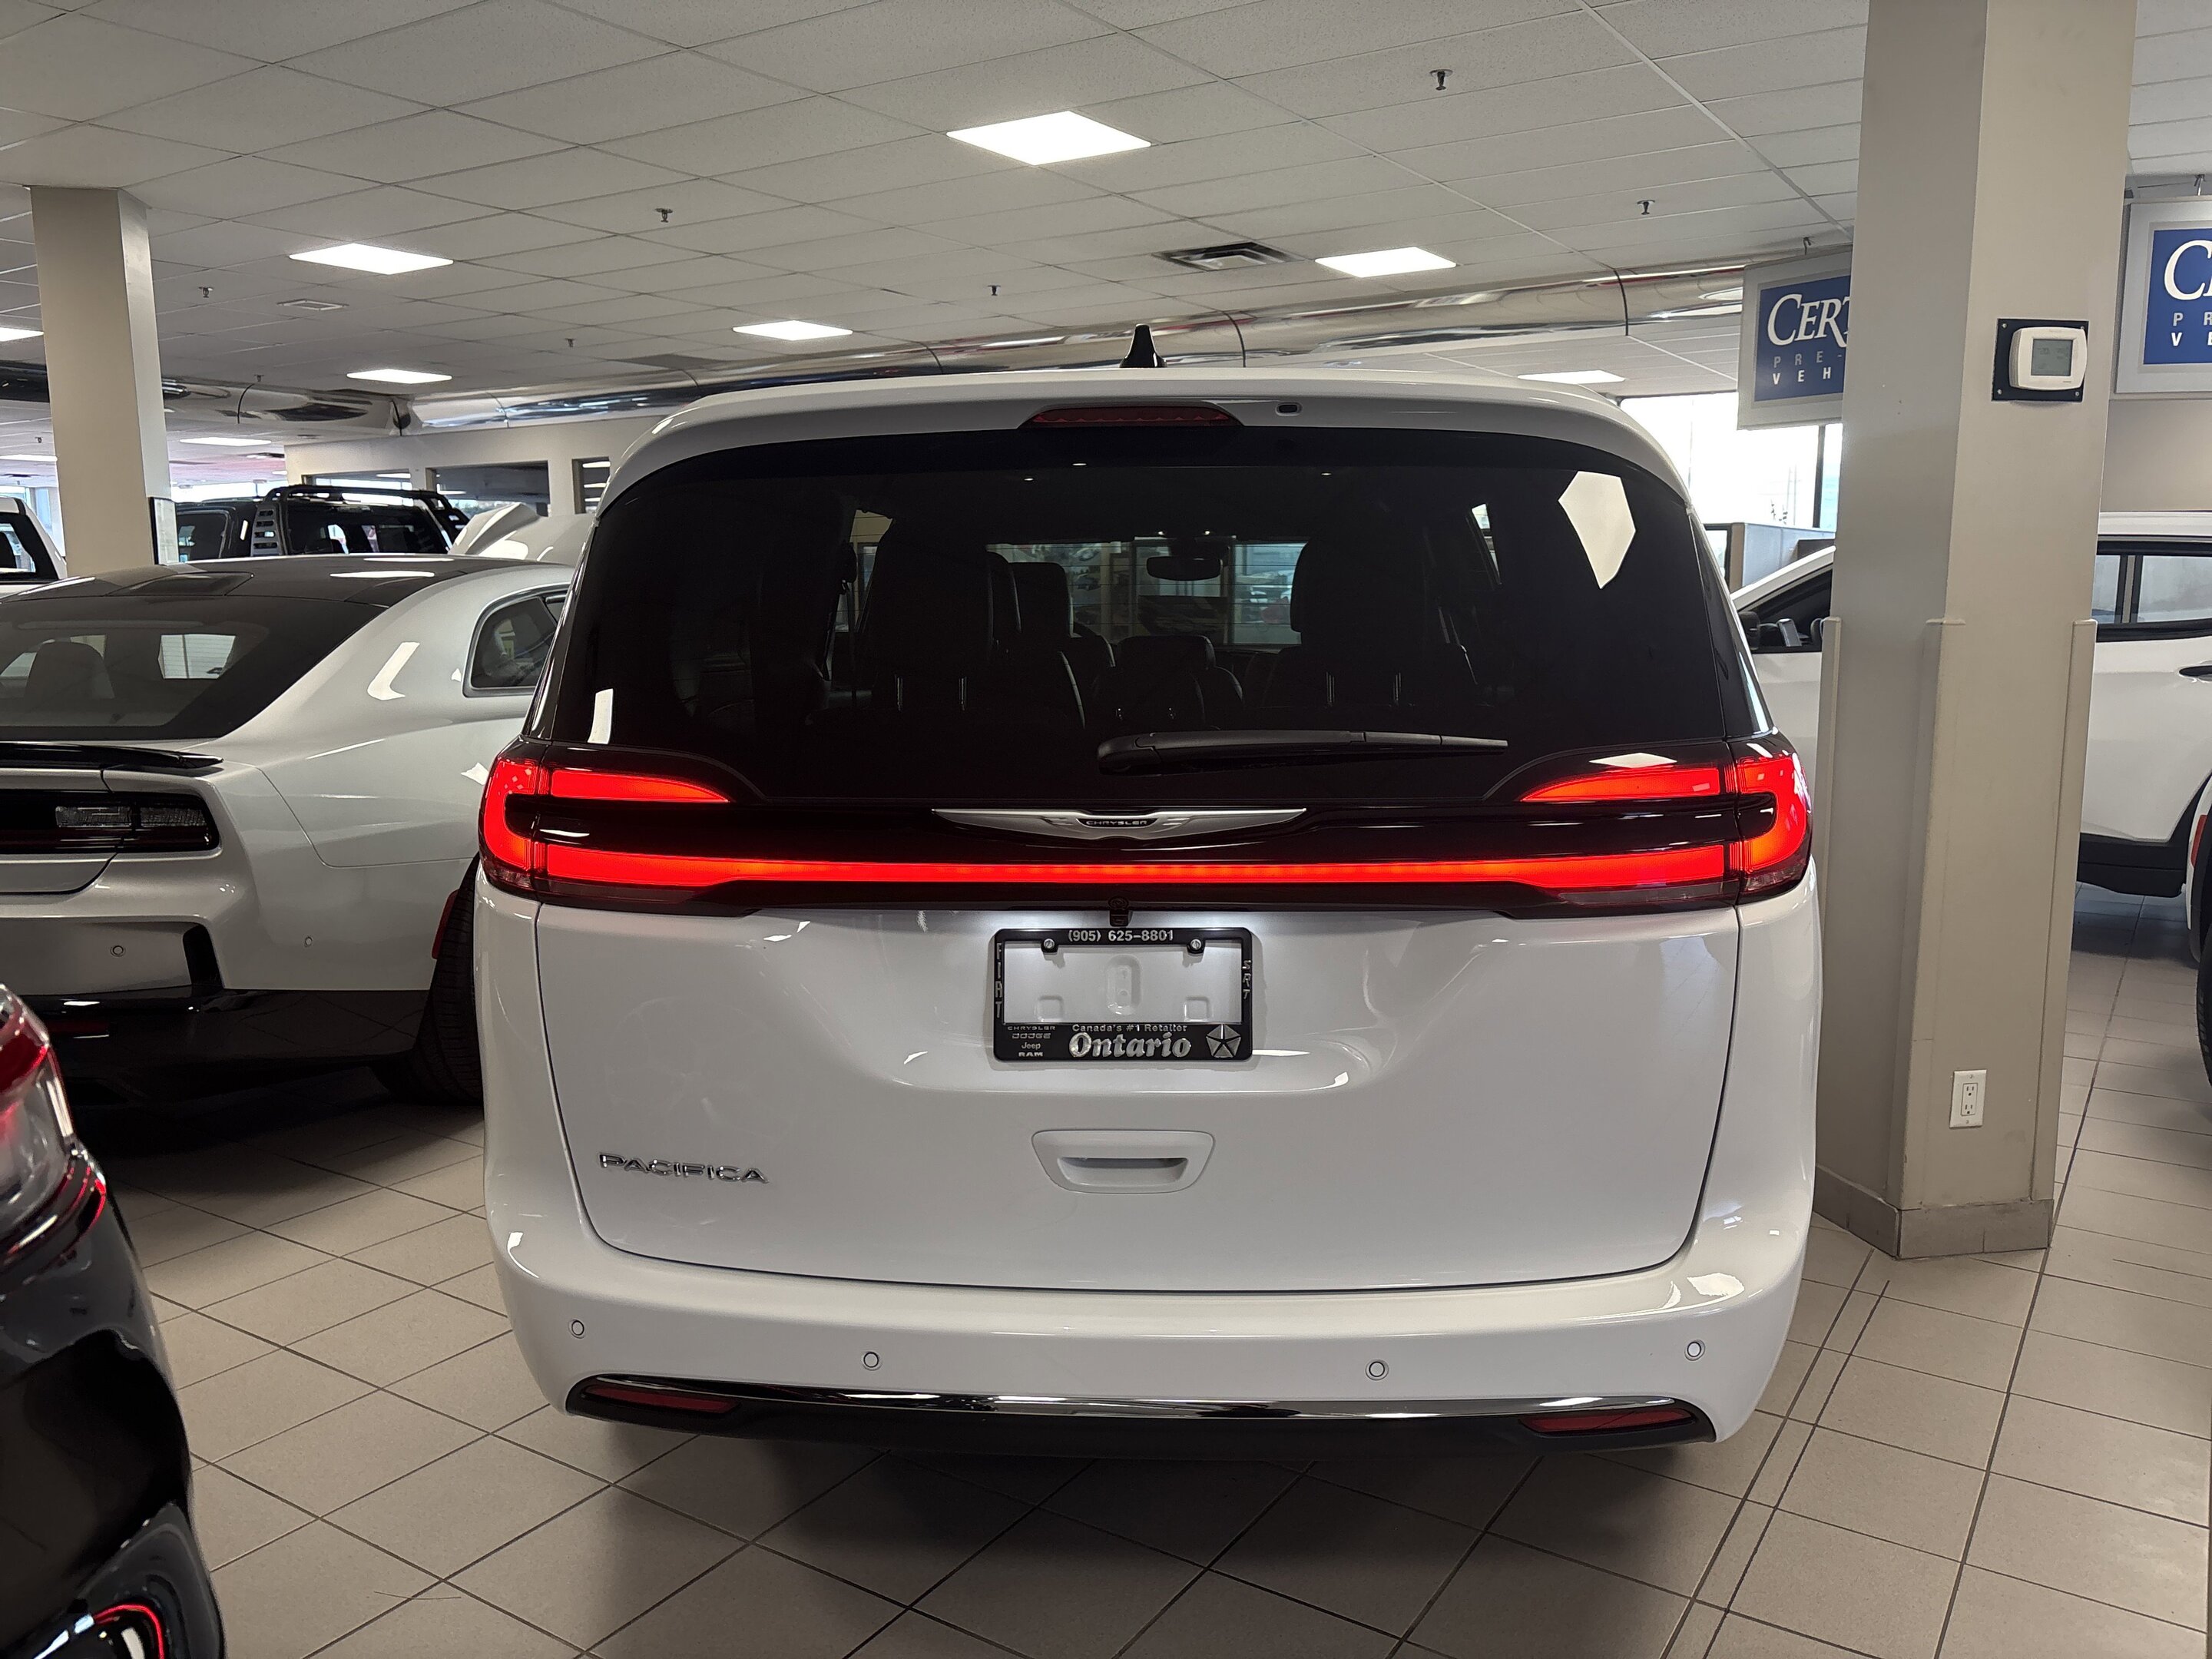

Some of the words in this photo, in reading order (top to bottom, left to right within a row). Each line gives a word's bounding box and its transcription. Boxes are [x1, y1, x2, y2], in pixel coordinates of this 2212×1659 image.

[1068, 929, 1101, 942] (905)
[1108, 929, 1174, 942] 625-8801
[1242, 960, 1251, 999] SRT
[1021, 1041, 1041, 1051] Jeep
[1069, 1031, 1191, 1058] Ontario
[599, 1152, 769, 1184] PACIFICA
